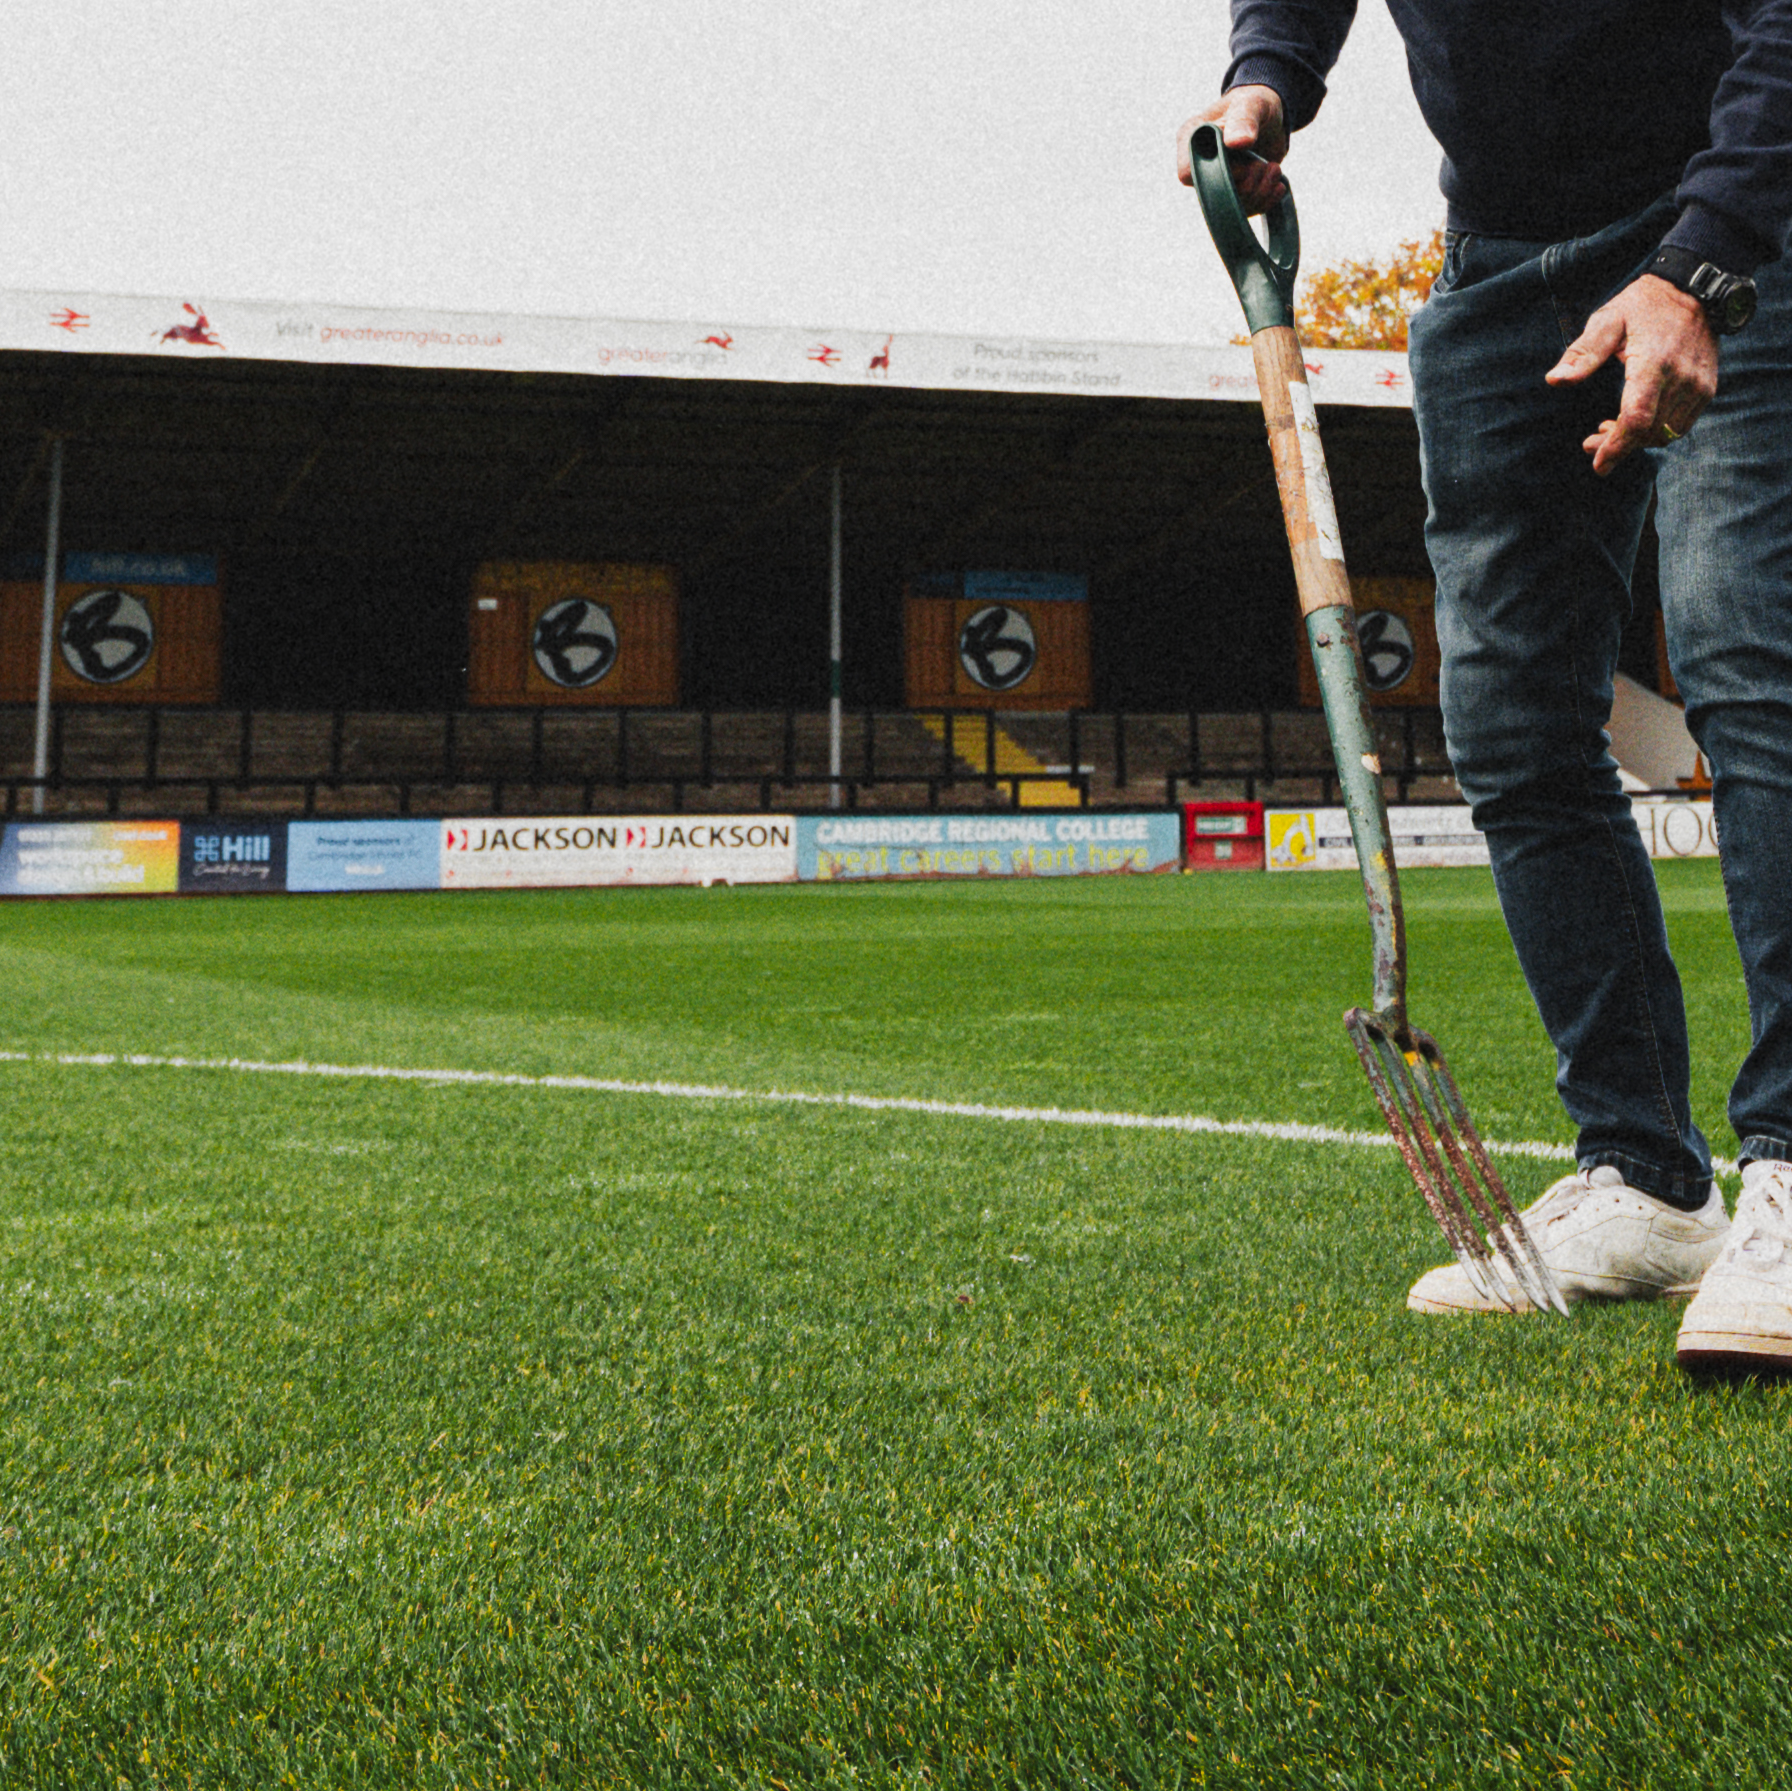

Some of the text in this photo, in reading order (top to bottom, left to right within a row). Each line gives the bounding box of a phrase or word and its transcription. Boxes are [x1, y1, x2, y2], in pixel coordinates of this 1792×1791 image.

[275, 320, 504, 349] Visit greateranglia.co.uk
[597, 345, 728, 368] greateranglia
[473, 823, 792, 853] JACKSON JACKSON
[816, 818, 1149, 844] CAMBRIDGE REGIONAL COLLEGE
[222, 835, 271, 861] Hill
[817, 846, 889, 880] great
[899, 849, 1001, 873] careers
[1011, 845, 1077, 872] start
[1087, 843, 1149, 869] here
